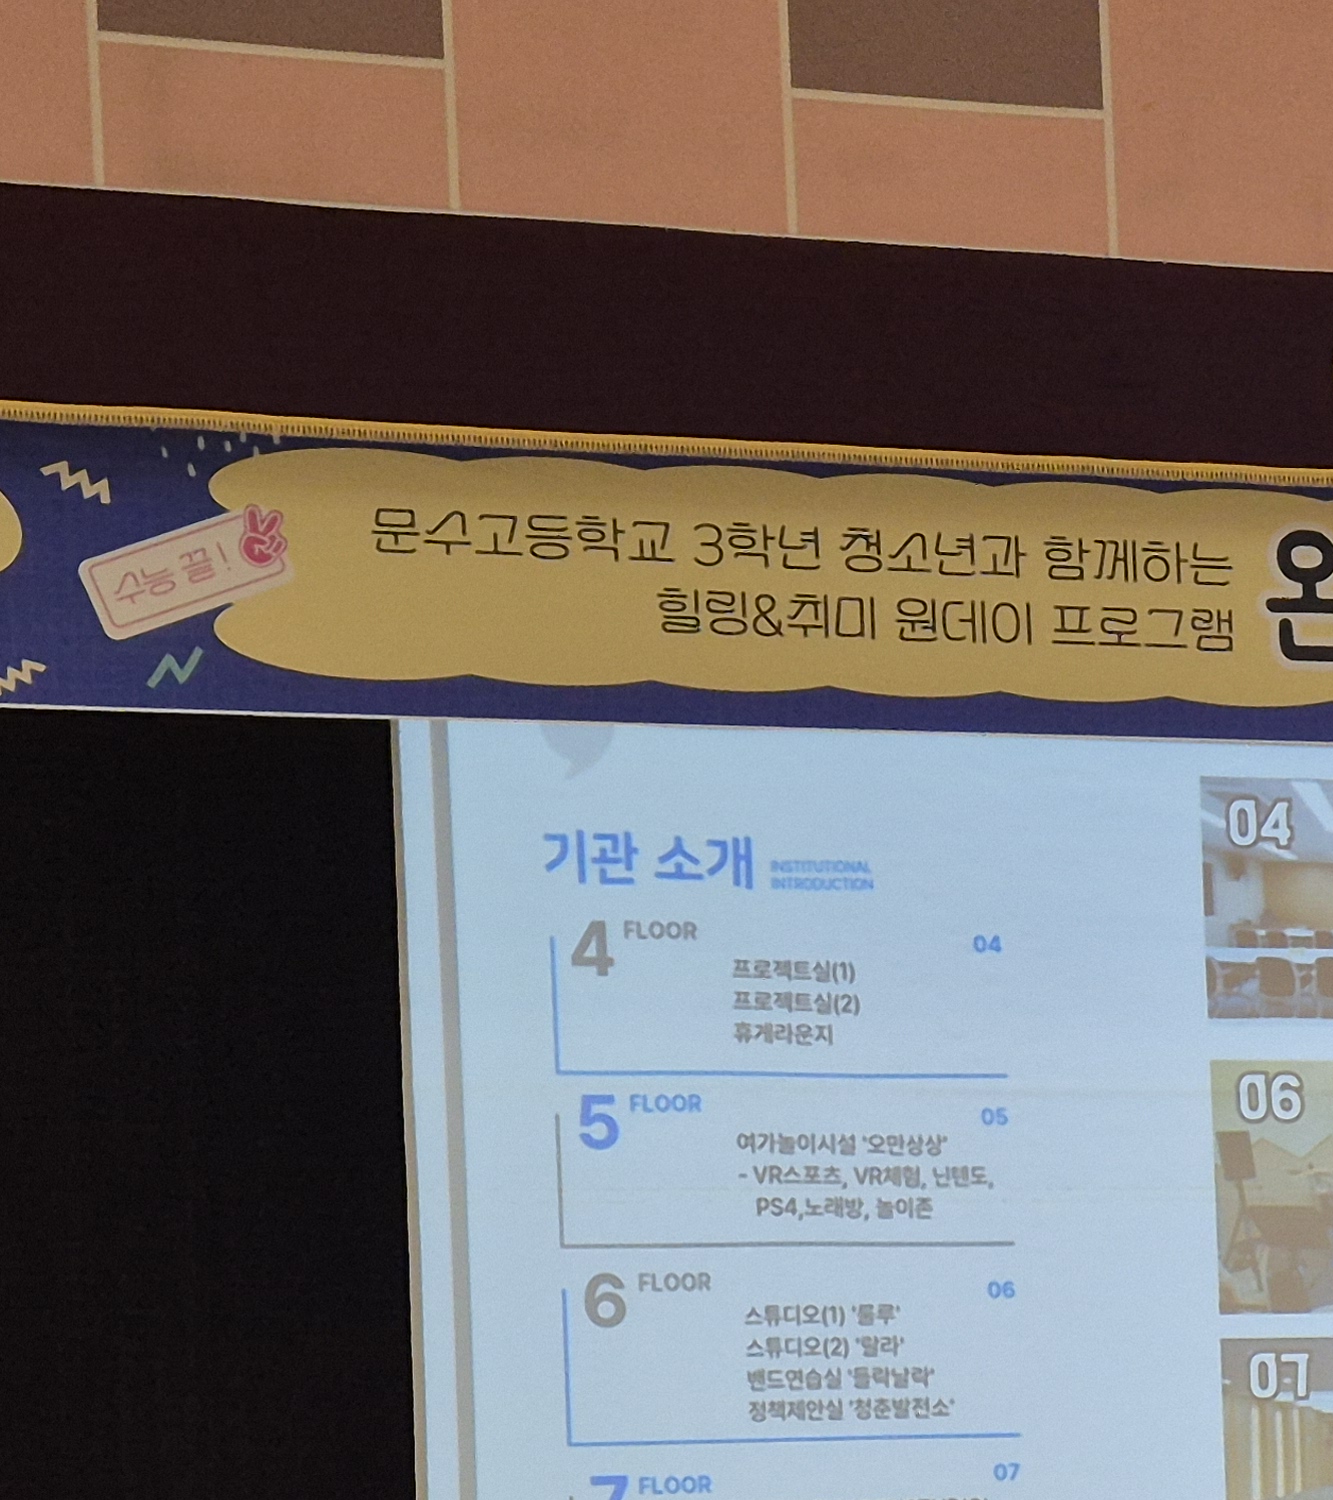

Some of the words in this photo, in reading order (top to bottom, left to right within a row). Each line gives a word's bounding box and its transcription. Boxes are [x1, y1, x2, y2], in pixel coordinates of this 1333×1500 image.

[371, 508, 675, 563] 문수고등학교
[693, 522, 820, 571] 3학년
[839, 527, 1027, 579] 청소년과
[1043, 535, 1233, 587] 함께하는
[114, 568, 177, 604] 수능
[657, 587, 875, 639] 힐링&취미
[895, 598, 1033, 646] 원데이
[1051, 604, 1234, 652] 프로그램
[1228, 799, 1294, 849] 04
[543, 829, 639, 885] 기관
[655, 835, 754, 890] 소개
[770, 860, 872, 875] INSTITUTIONAL
[770, 876, 874, 891] INTRODUCTION
[571, 920, 615, 976] 4
[623, 921, 698, 941] FLOOR
[972, 935, 1002, 953] 04
[733, 959, 856, 984] 프로젝트실(1)
[733, 991, 861, 1016] 프로젝트실(2)
[734, 1023, 834, 1047] 휴게라운지
[1237, 1074, 1304, 1121] 06
[579, 1094, 620, 1151] 5
[629, 1095, 702, 1113] FLOOR
[981, 1108, 1009, 1126] 05
[737, 1132, 857, 1155] 여가놀이시설
[753, 1165, 848, 1189] VR스포츠,
[584, 1272, 627, 1328] 6
[638, 1272, 711, 1292] FLOOR
[987, 1281, 1016, 1299] 06
[745, 1304, 845, 1327] 스튜디오(1)
[746, 1336, 850, 1359] 스튜디오(2)
[747, 1367, 842, 1392] 밴드연습실
[1249, 1352, 1311, 1401] 07
[993, 1463, 1021, 1481] 07
[638, 1476, 712, 1495] FLOOR
